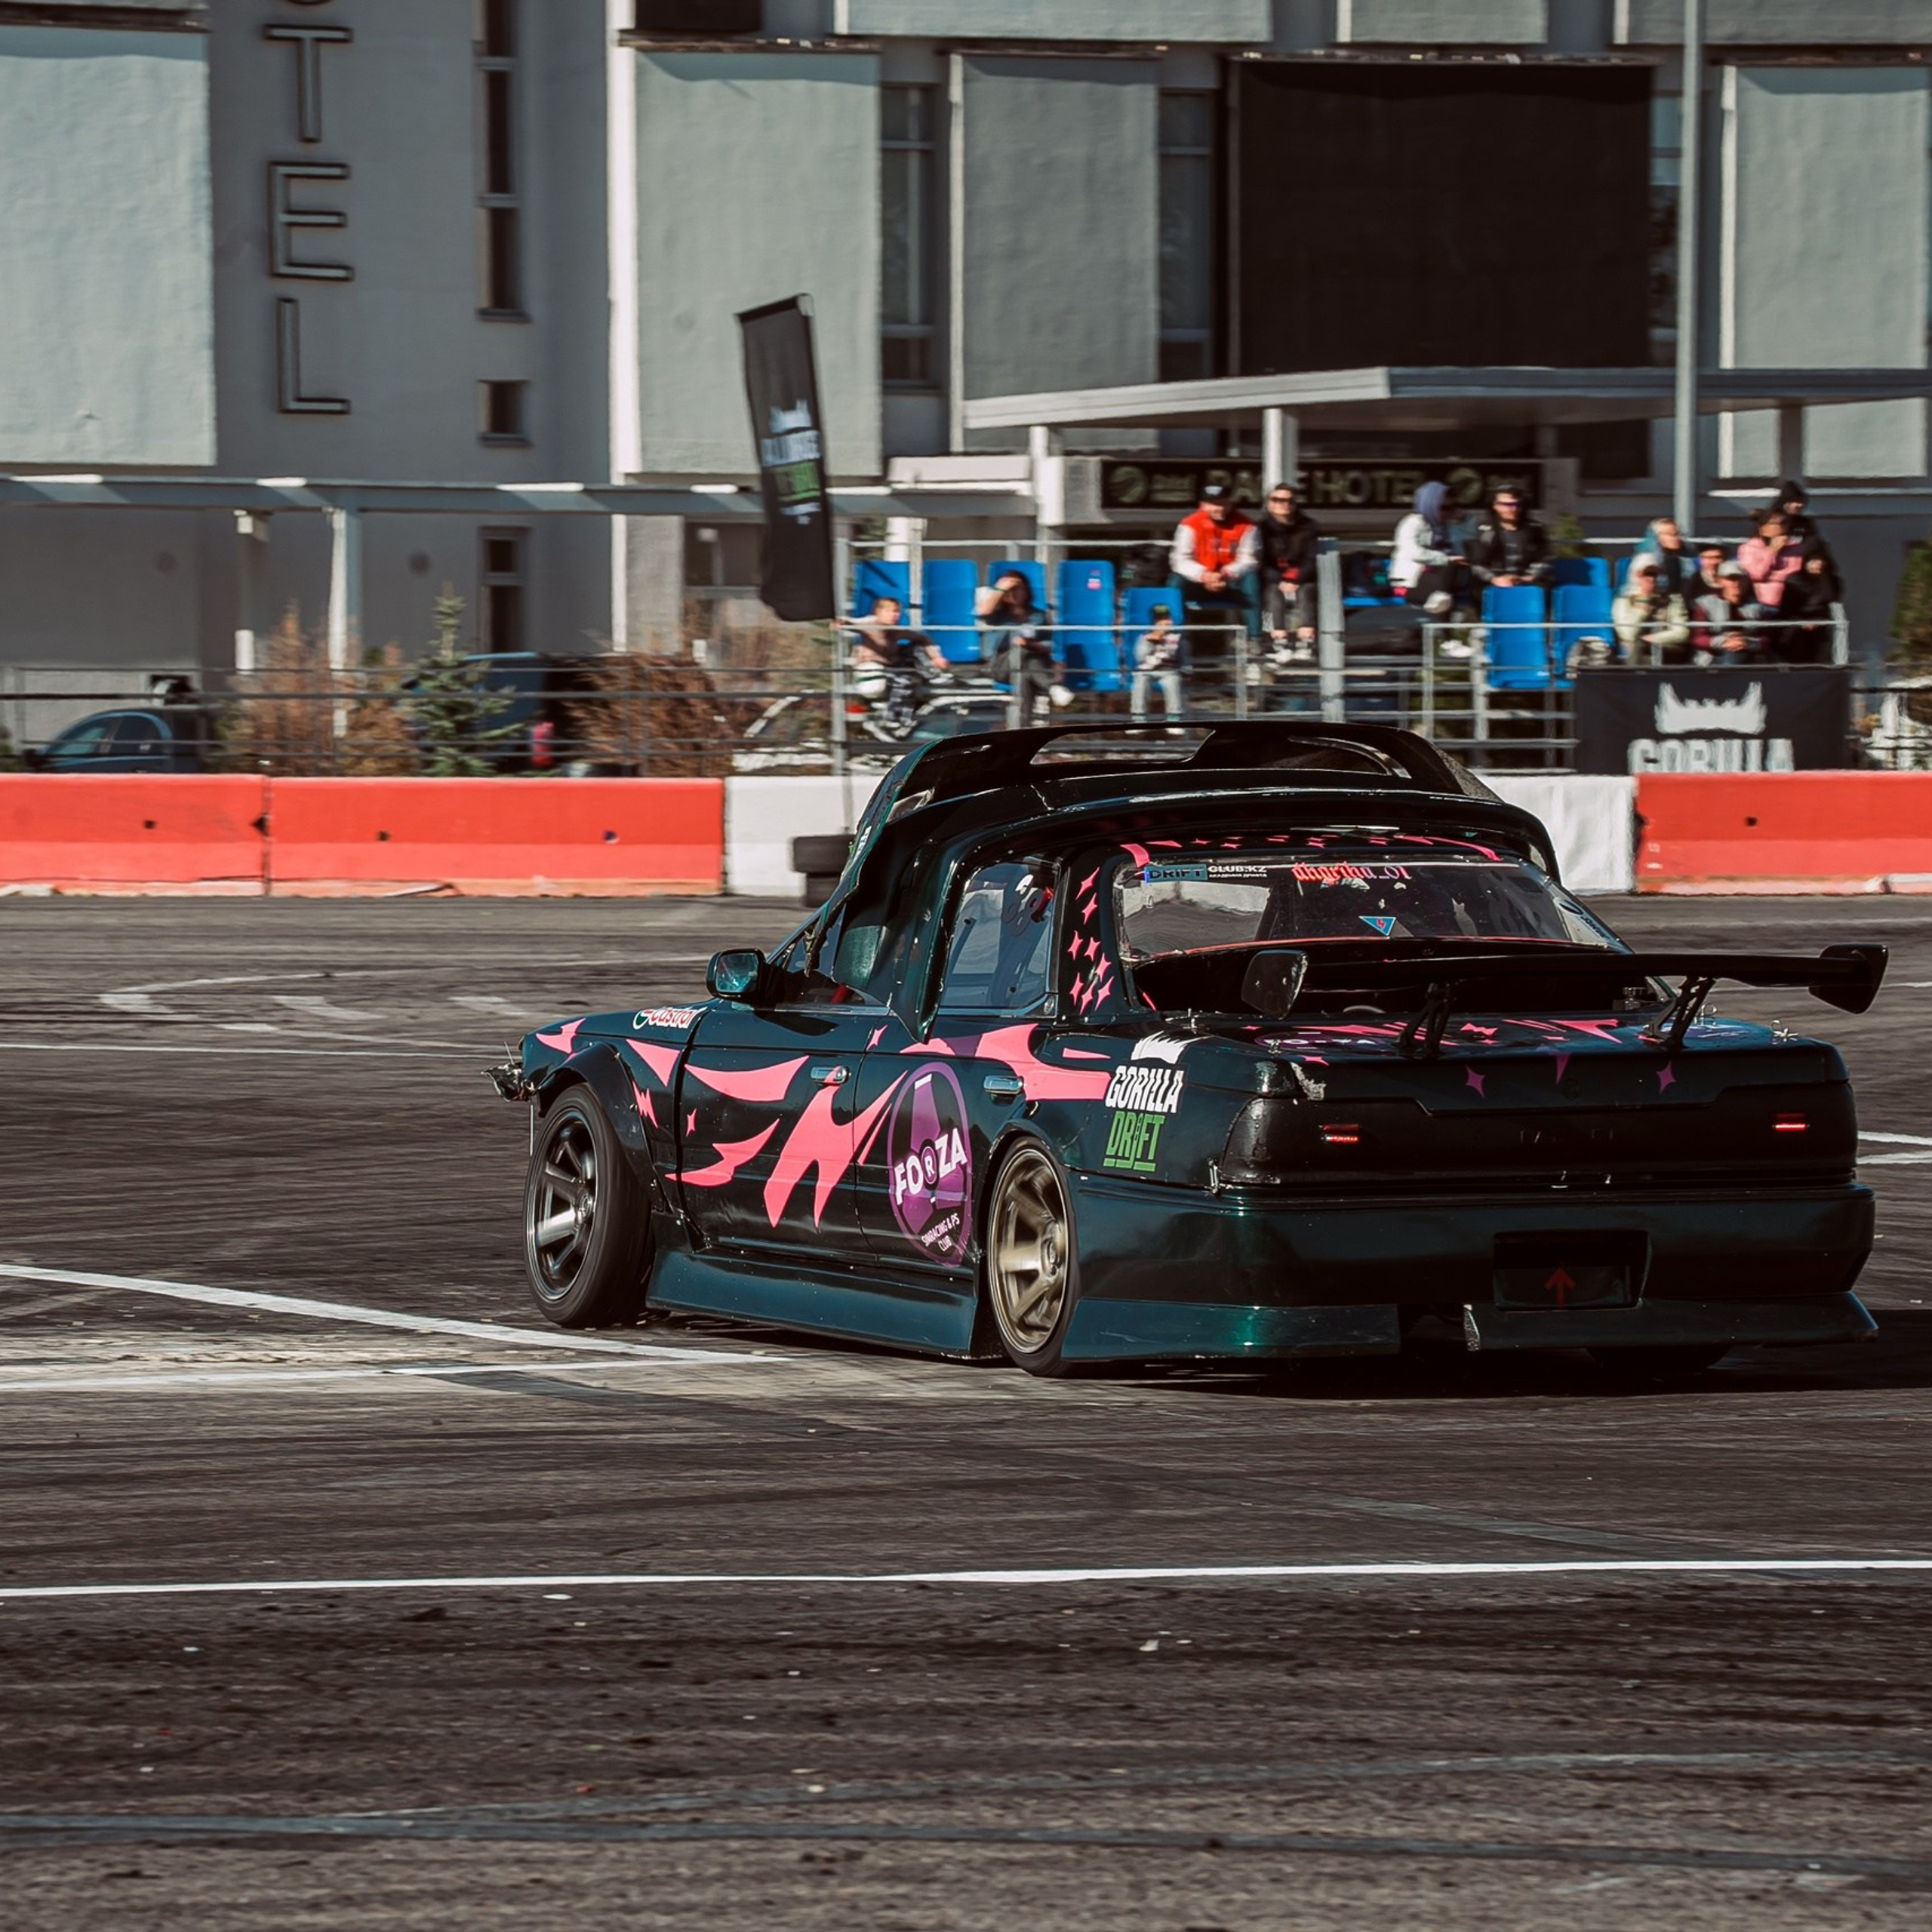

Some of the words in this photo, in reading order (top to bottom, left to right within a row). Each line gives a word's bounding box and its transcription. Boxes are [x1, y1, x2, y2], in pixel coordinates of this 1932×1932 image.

[262, 0, 355, 414] TEL
[1149, 869, 1203, 879] DRIFT
[1105, 1065, 1184, 1114] GORILLA
[1105, 1110, 1166, 1166] DRIFT
[894, 1128, 968, 1206] FORZA
